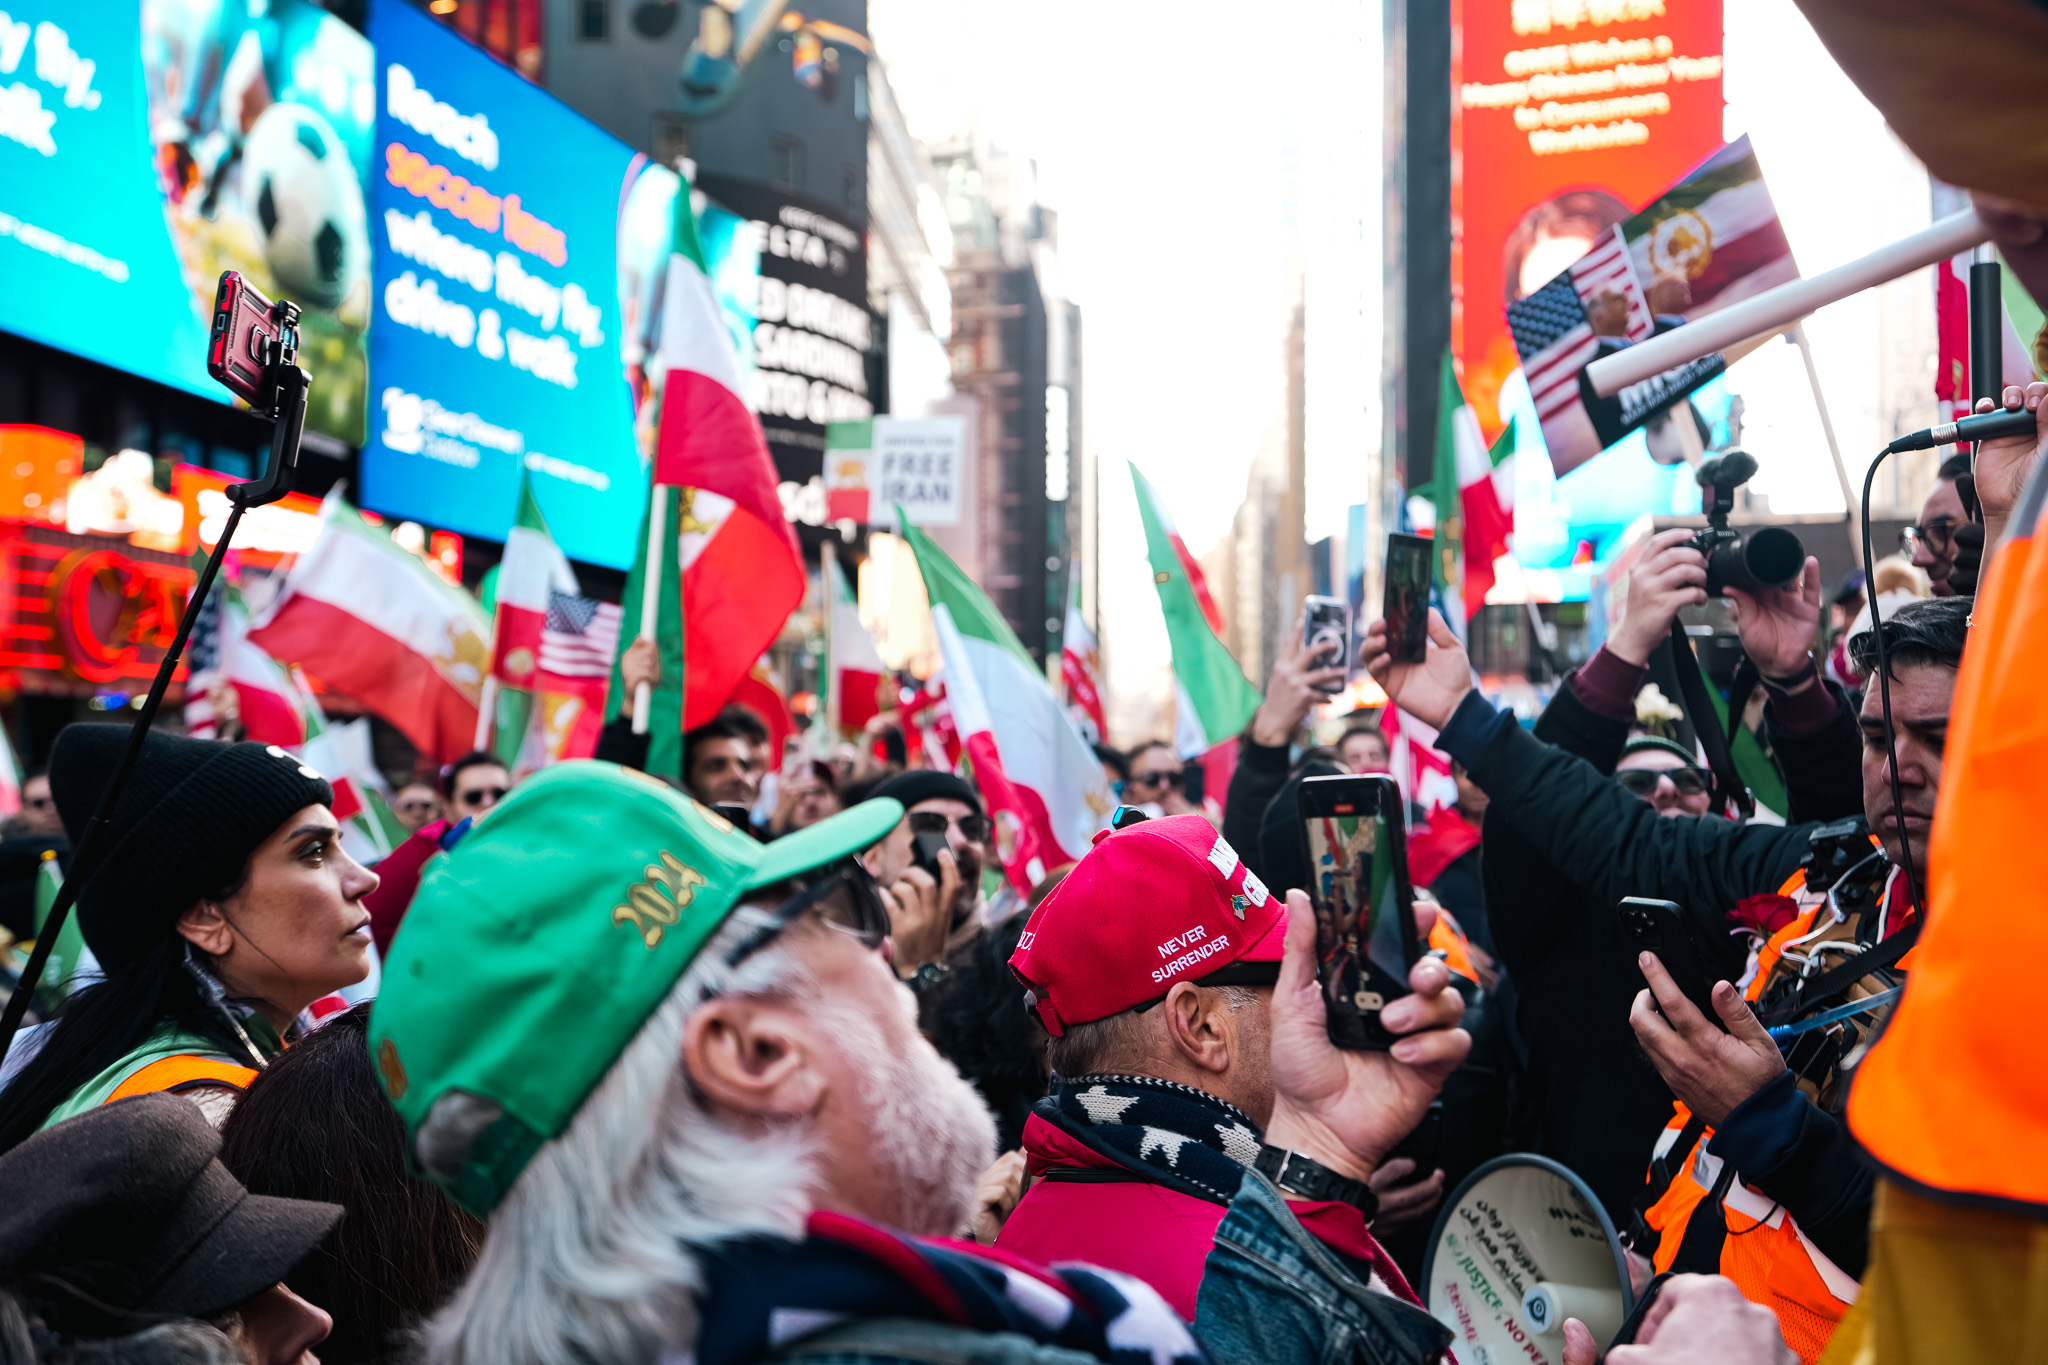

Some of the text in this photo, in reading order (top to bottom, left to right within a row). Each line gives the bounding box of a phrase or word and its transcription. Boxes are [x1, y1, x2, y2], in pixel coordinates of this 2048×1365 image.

[387, 63, 499, 171] Reach
[385, 142, 568, 267] soccer fans
[384, 208, 494, 292] where
[495, 251, 563, 331] they
[385, 271, 476, 348] drive
[506, 327, 578, 389] walk
[880, 481, 951, 504] IRAN
[882, 452, 953, 476] FREE
[612, 849, 706, 951] 2024
[1151, 935, 1230, 983] SURRENDER
[1157, 925, 1207, 959] NEVER
[1503, 1317, 1526, 1344] NO
